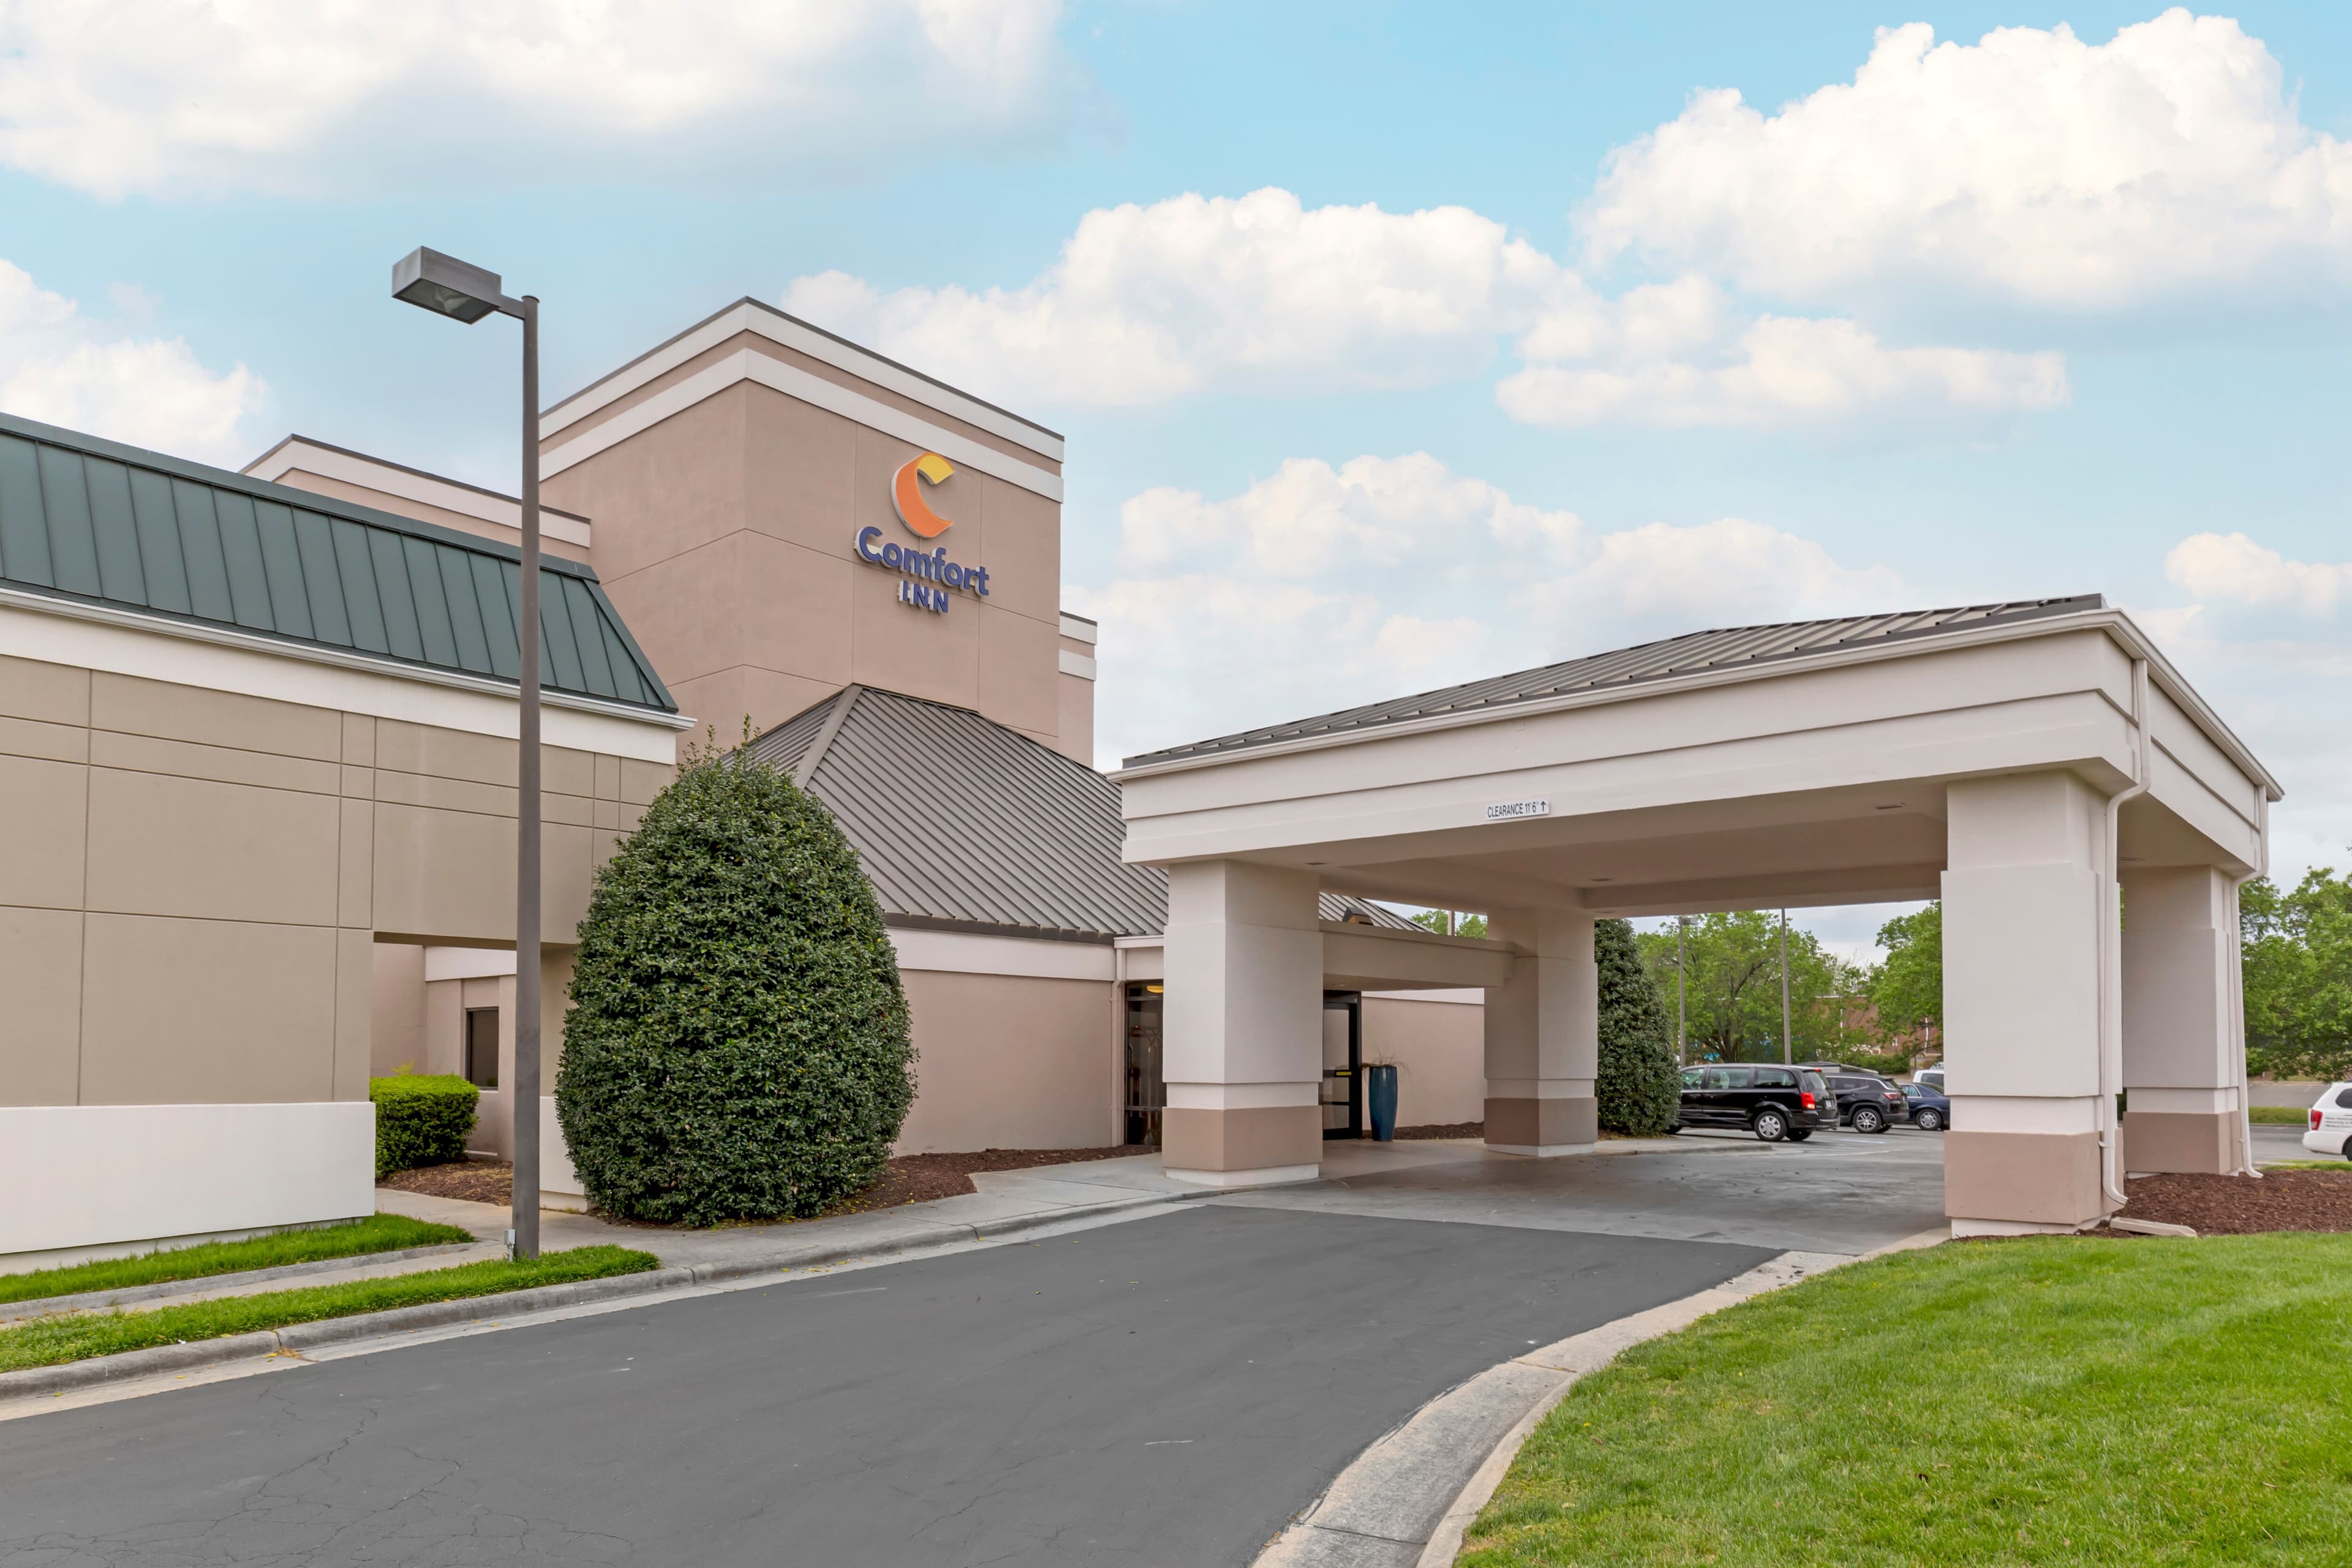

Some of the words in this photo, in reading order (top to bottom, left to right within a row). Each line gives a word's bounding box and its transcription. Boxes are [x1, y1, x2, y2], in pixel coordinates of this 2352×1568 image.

[855, 526, 990, 596] Comfort
[899, 580, 949, 613] INN
[1487, 803, 1523, 818] CLEARANCE
